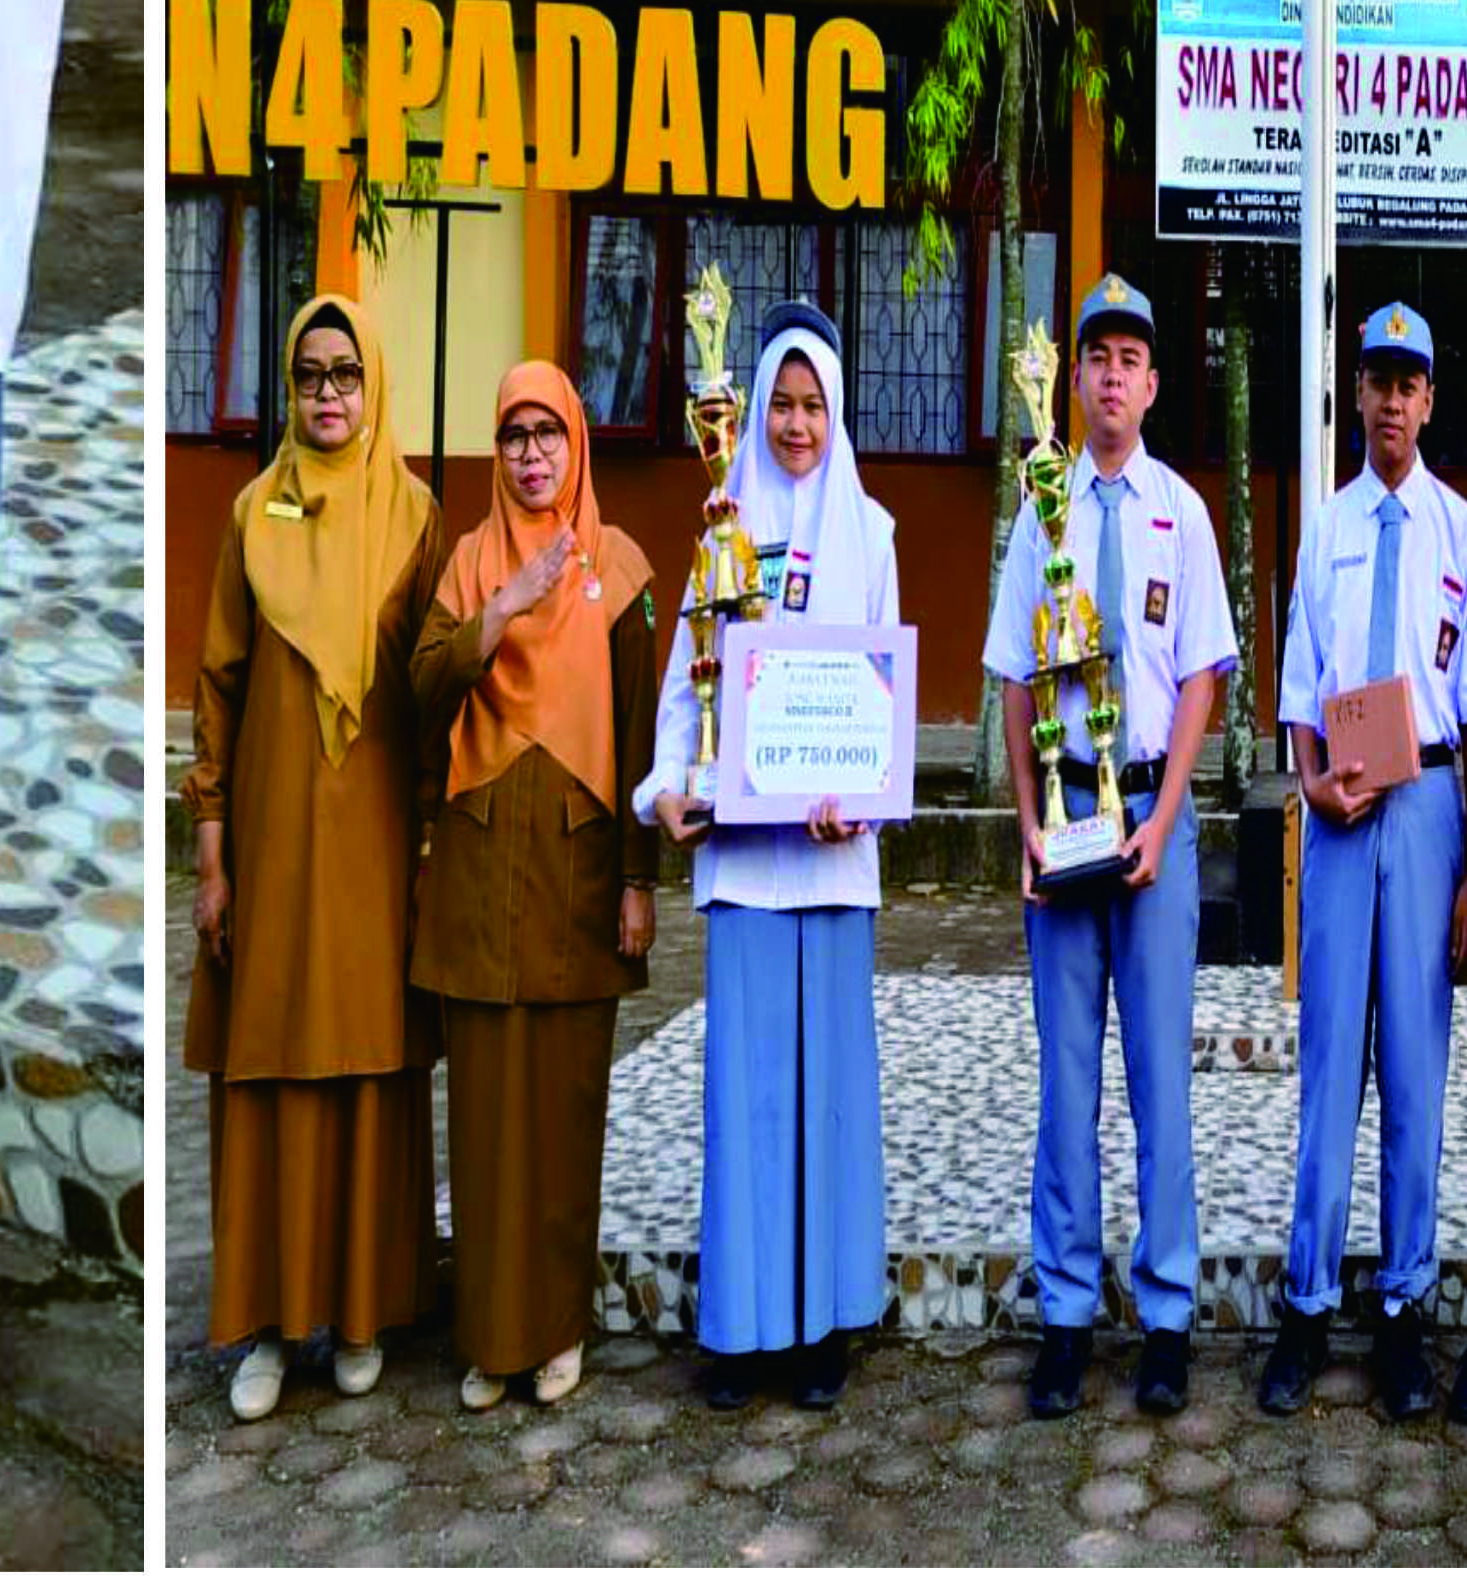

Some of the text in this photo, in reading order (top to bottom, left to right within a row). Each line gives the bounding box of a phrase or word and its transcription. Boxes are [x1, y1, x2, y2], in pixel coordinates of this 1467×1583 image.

[1177, 45, 1237, 110] SMA
[1371, 53, 1386, 115] 4
[1182, 157, 1226, 175] SEKOLAH
[1228, 159, 1273, 176] STANDAR
[755, 744, 878, 769] (RP 750.000)
